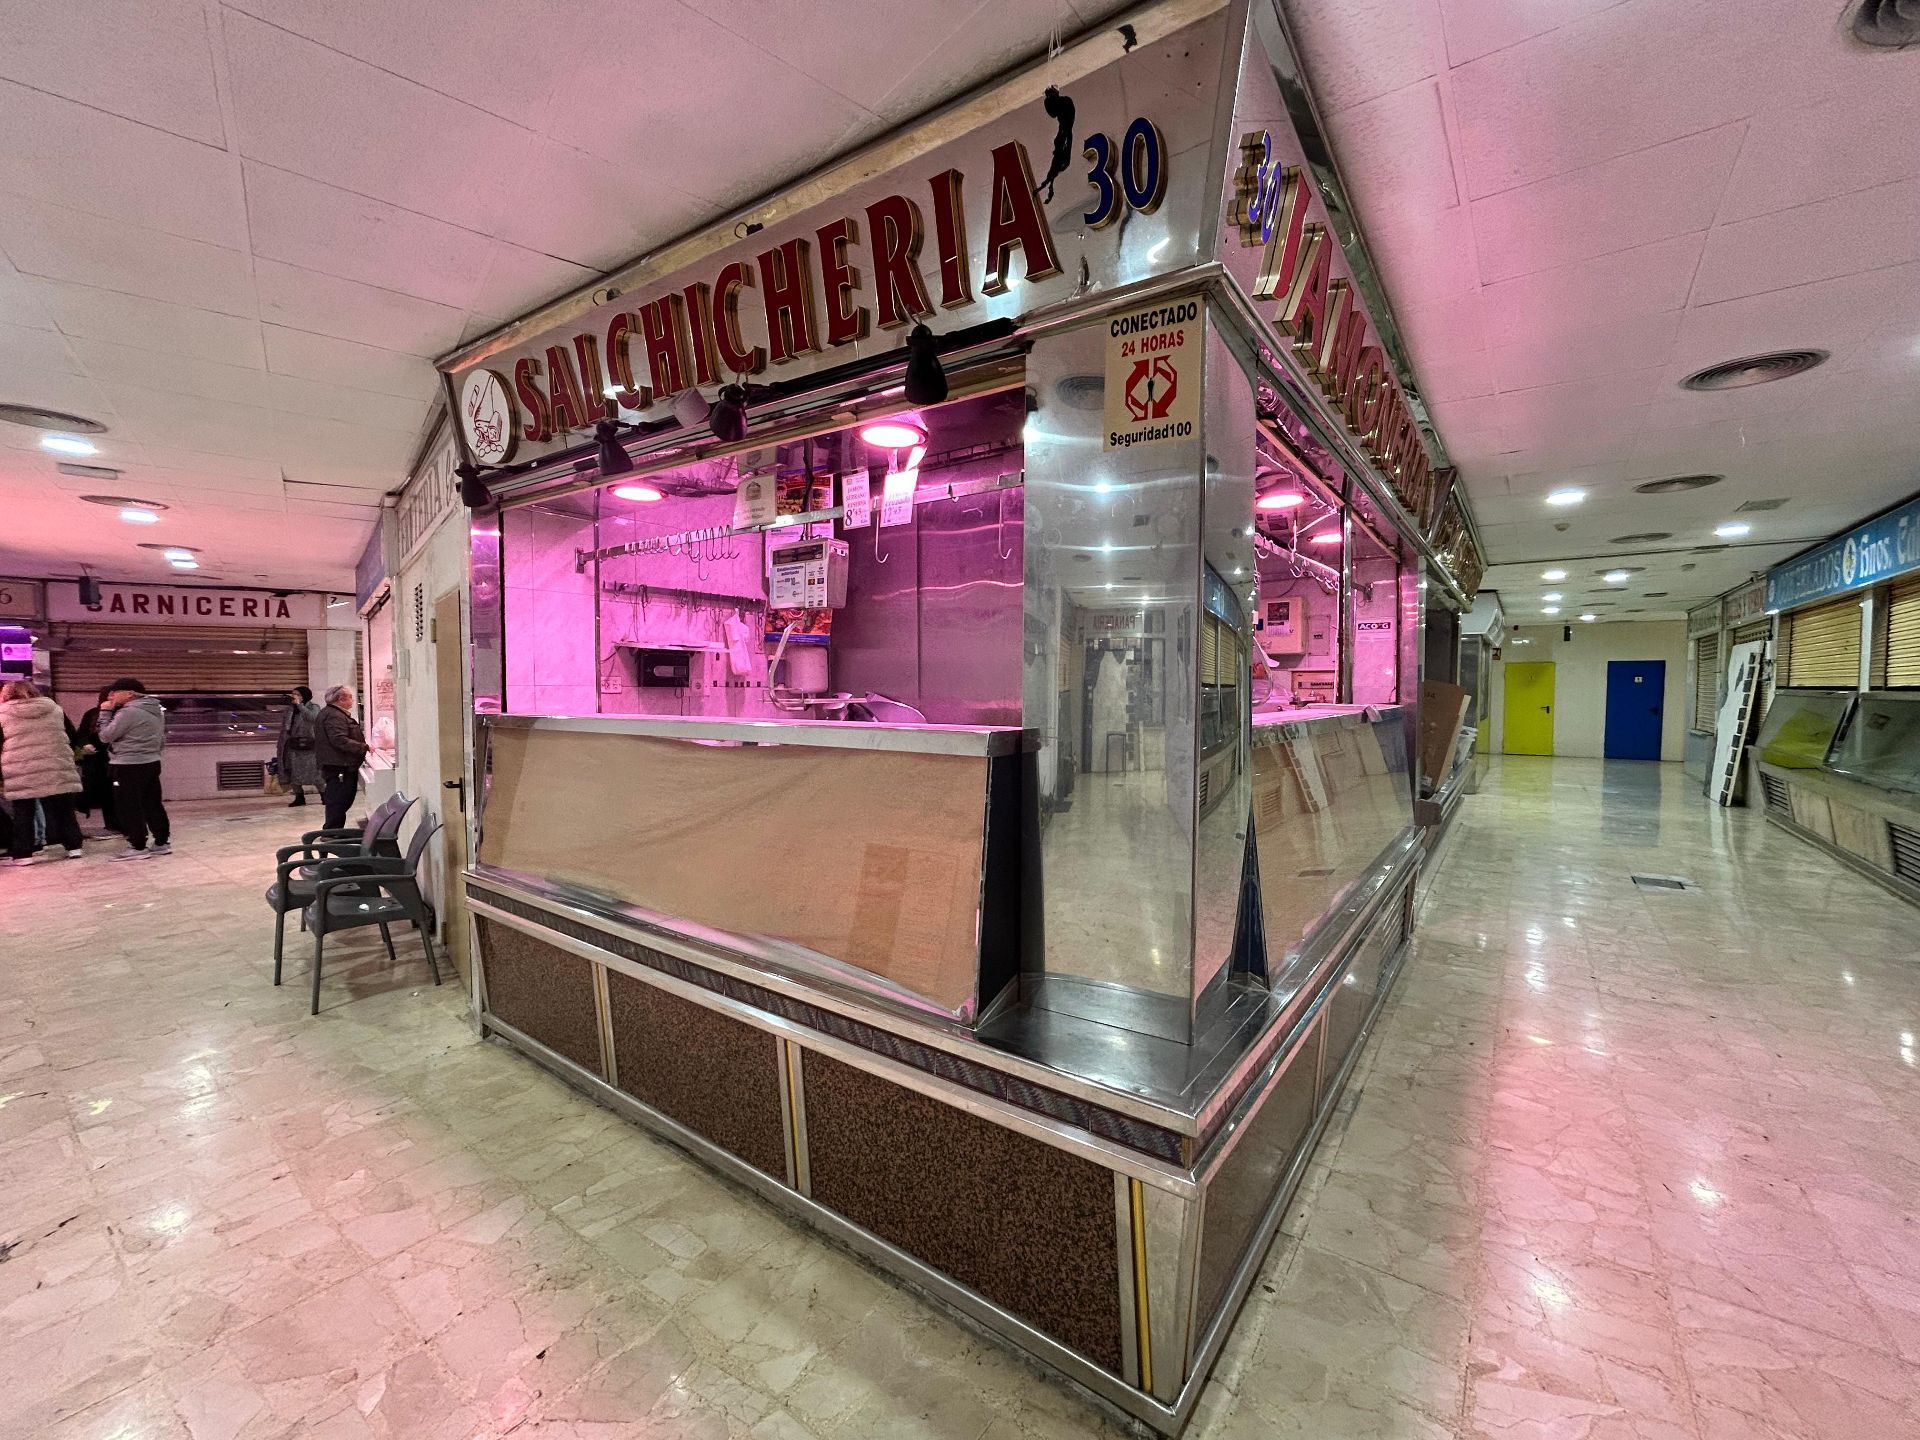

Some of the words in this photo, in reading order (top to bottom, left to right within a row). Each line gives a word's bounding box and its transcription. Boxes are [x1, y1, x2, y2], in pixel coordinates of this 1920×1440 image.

[515, 140, 1062, 442] SALCHICHERIA
[1083, 117, 1167, 229] 30
[1110, 302, 1198, 338] CONECTADO
[1121, 341, 1136, 358] 24
[1141, 330, 1185, 354] HORAS
[1258, 165, 1429, 516] JAMONERIA
[1110, 421, 1192, 447] Seguridad100
